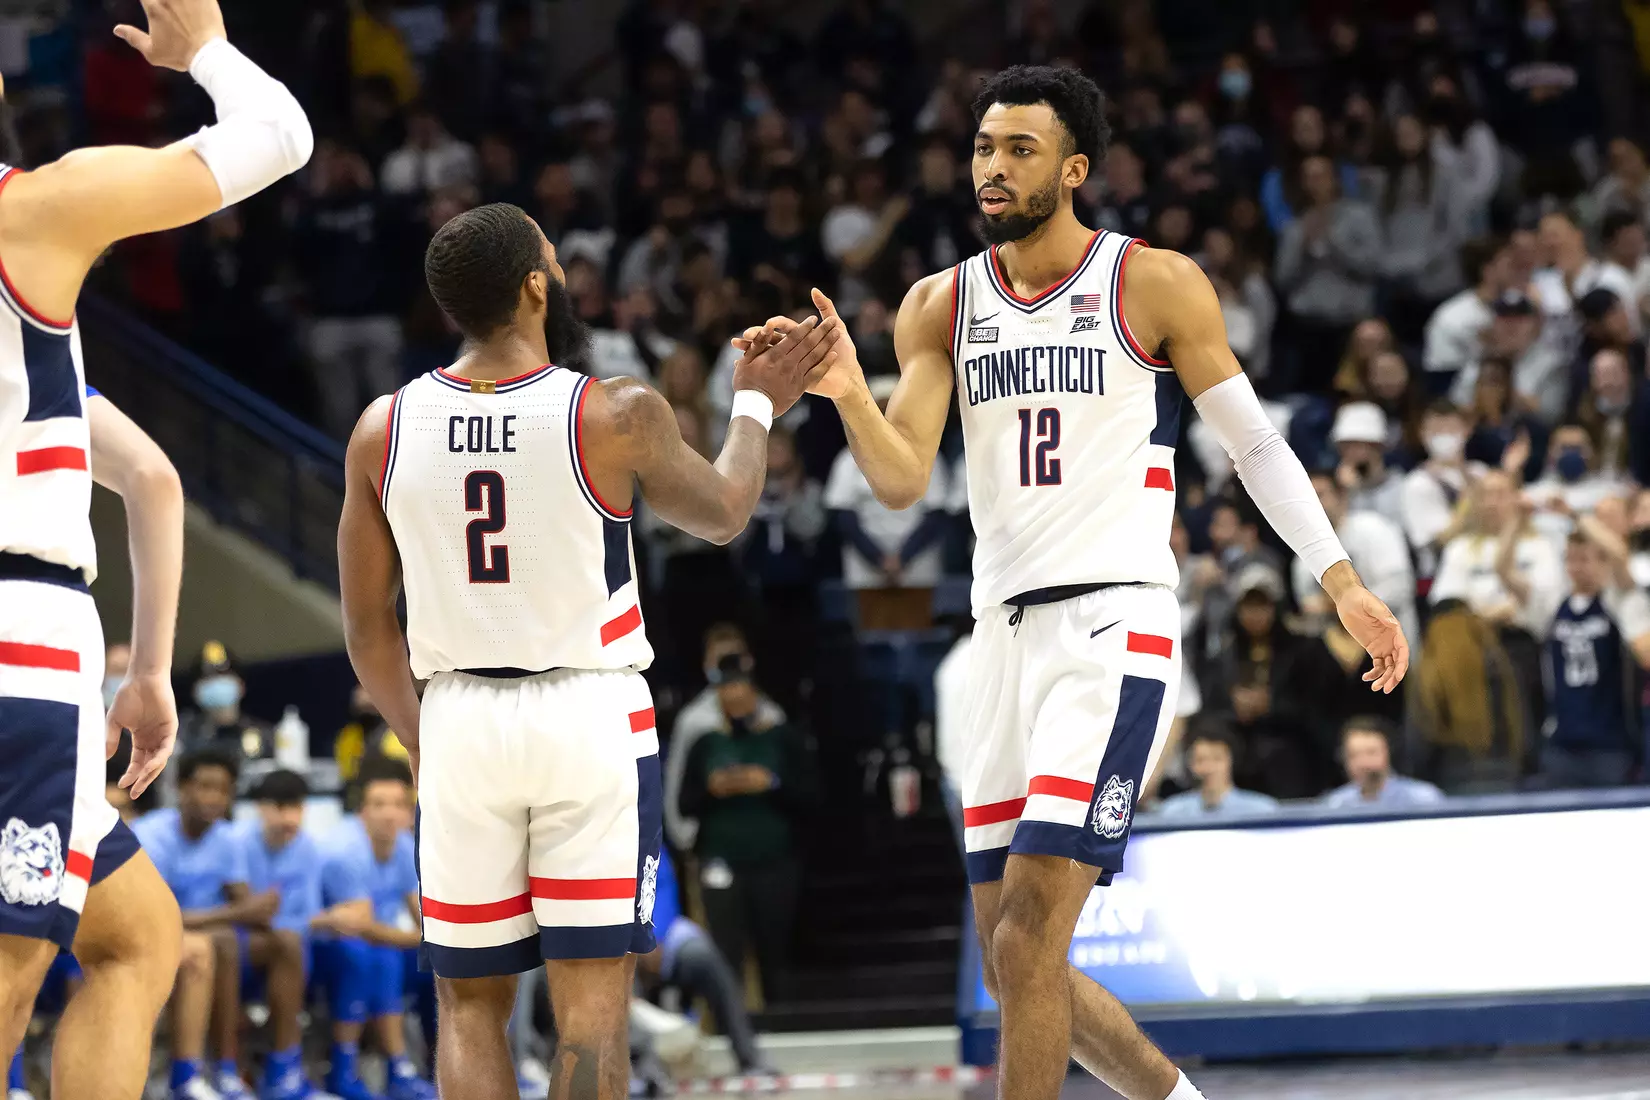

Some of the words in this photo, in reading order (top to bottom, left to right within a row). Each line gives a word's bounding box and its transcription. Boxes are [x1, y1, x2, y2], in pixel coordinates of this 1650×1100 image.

[1071, 321, 1101, 331] EAST
[1075, 315, 1095, 324] BIG
[965, 346, 1106, 407] CONNECTICUT
[448, 415, 516, 452] COLE
[1018, 407, 1062, 487] 12
[464, 470, 510, 583] 2
